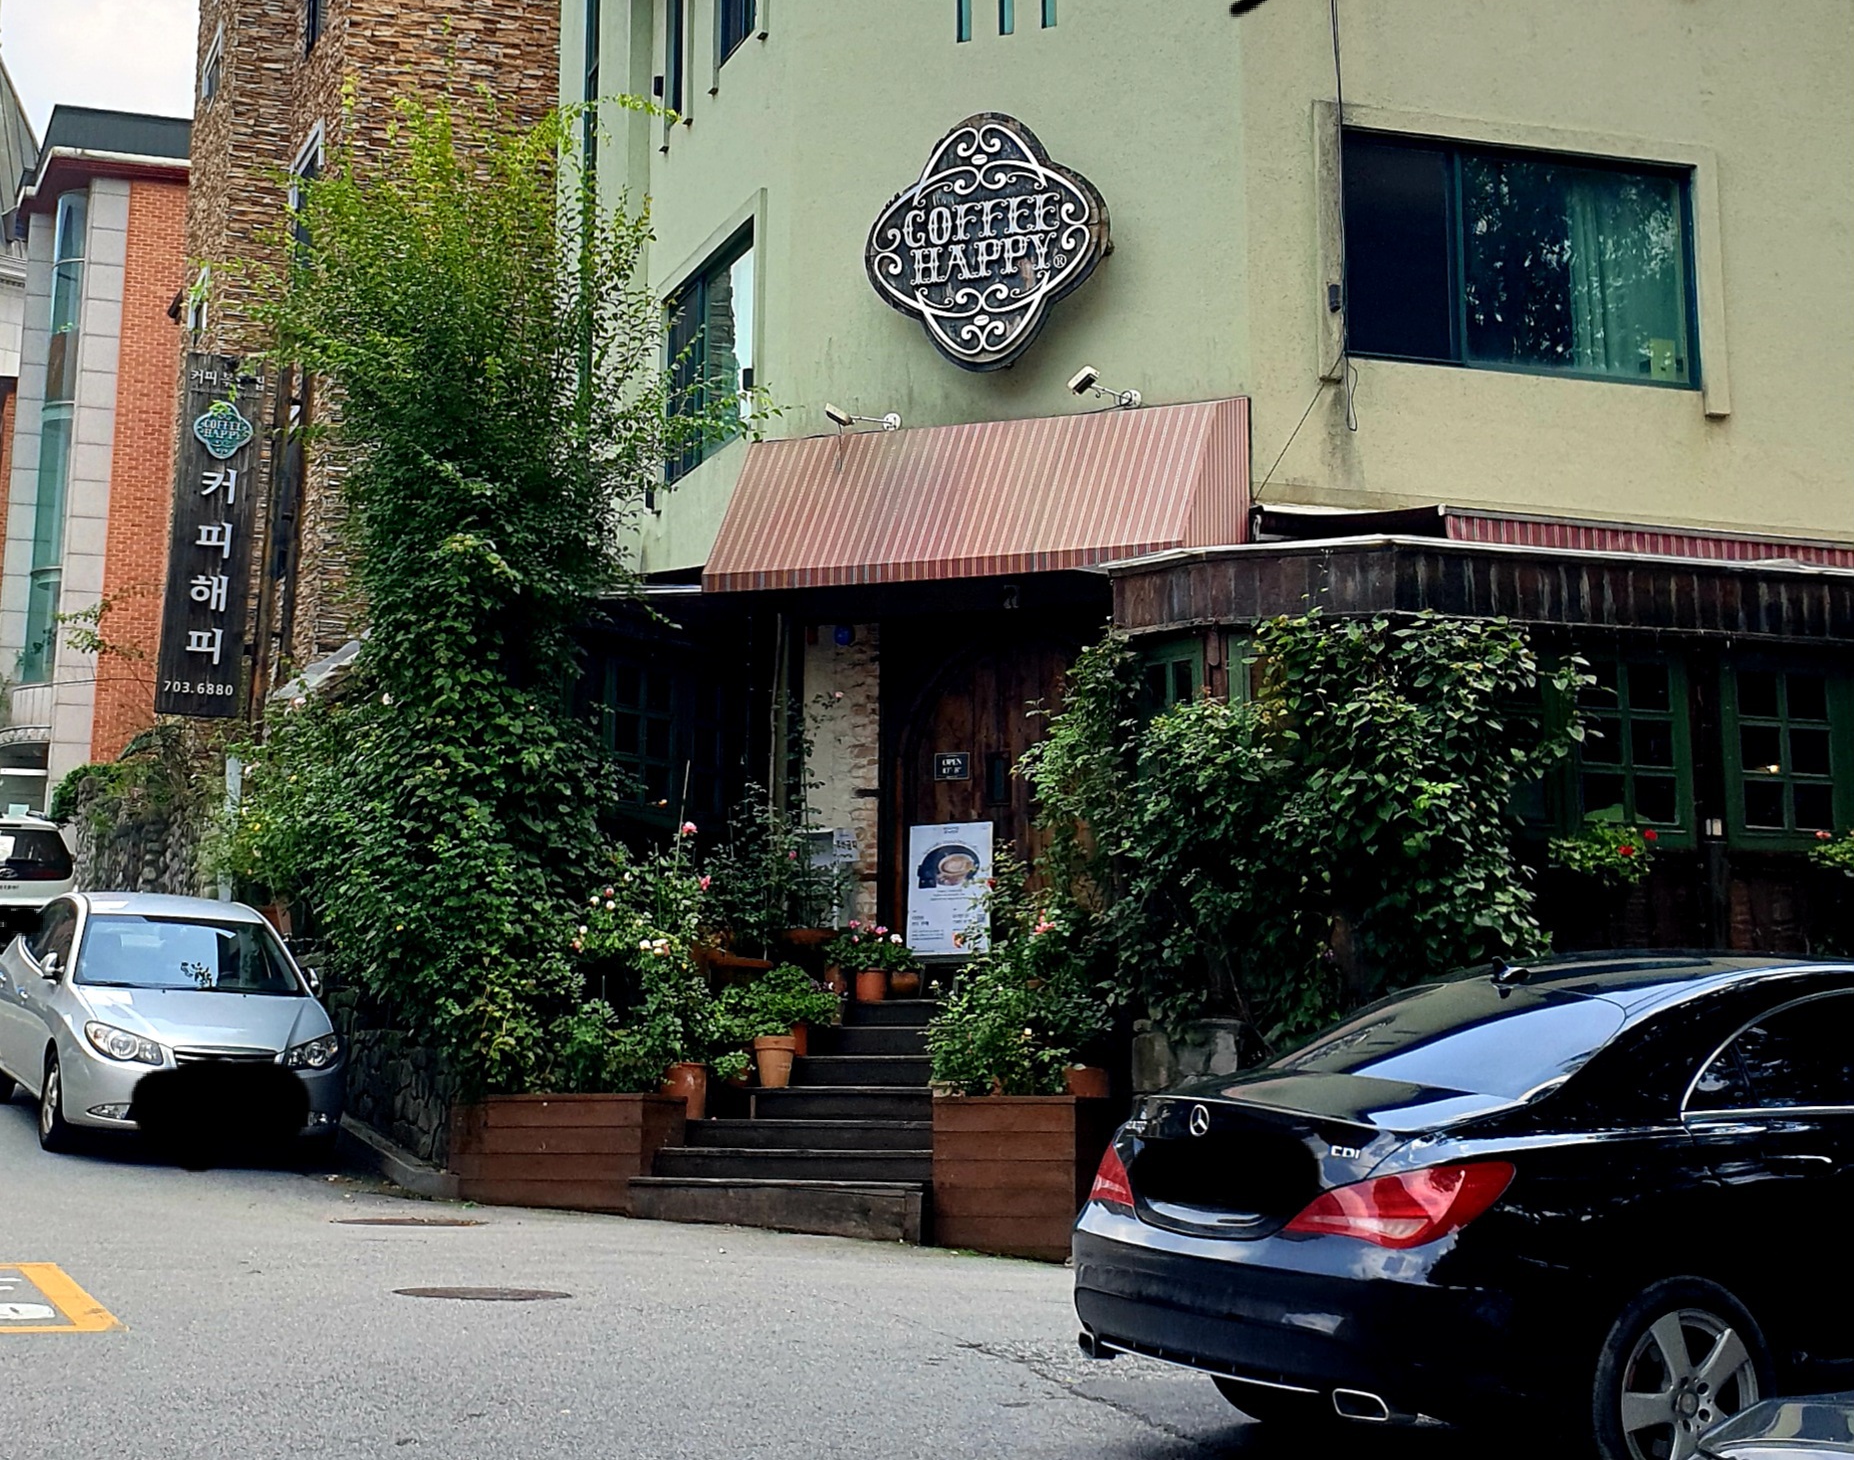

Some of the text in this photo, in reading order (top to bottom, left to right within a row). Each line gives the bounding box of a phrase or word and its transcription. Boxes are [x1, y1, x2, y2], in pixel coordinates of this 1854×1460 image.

[902, 193, 1060, 248] COFFEE
[910, 232, 1058, 286] HAPPY
[190, 369, 217, 385] 커피
[203, 419, 241, 431] COFFEE
[203, 429, 240, 439] HAPPY
[163, 680, 234, 696] 703.6880
[1331, 1145, 1361, 1159] CDI
